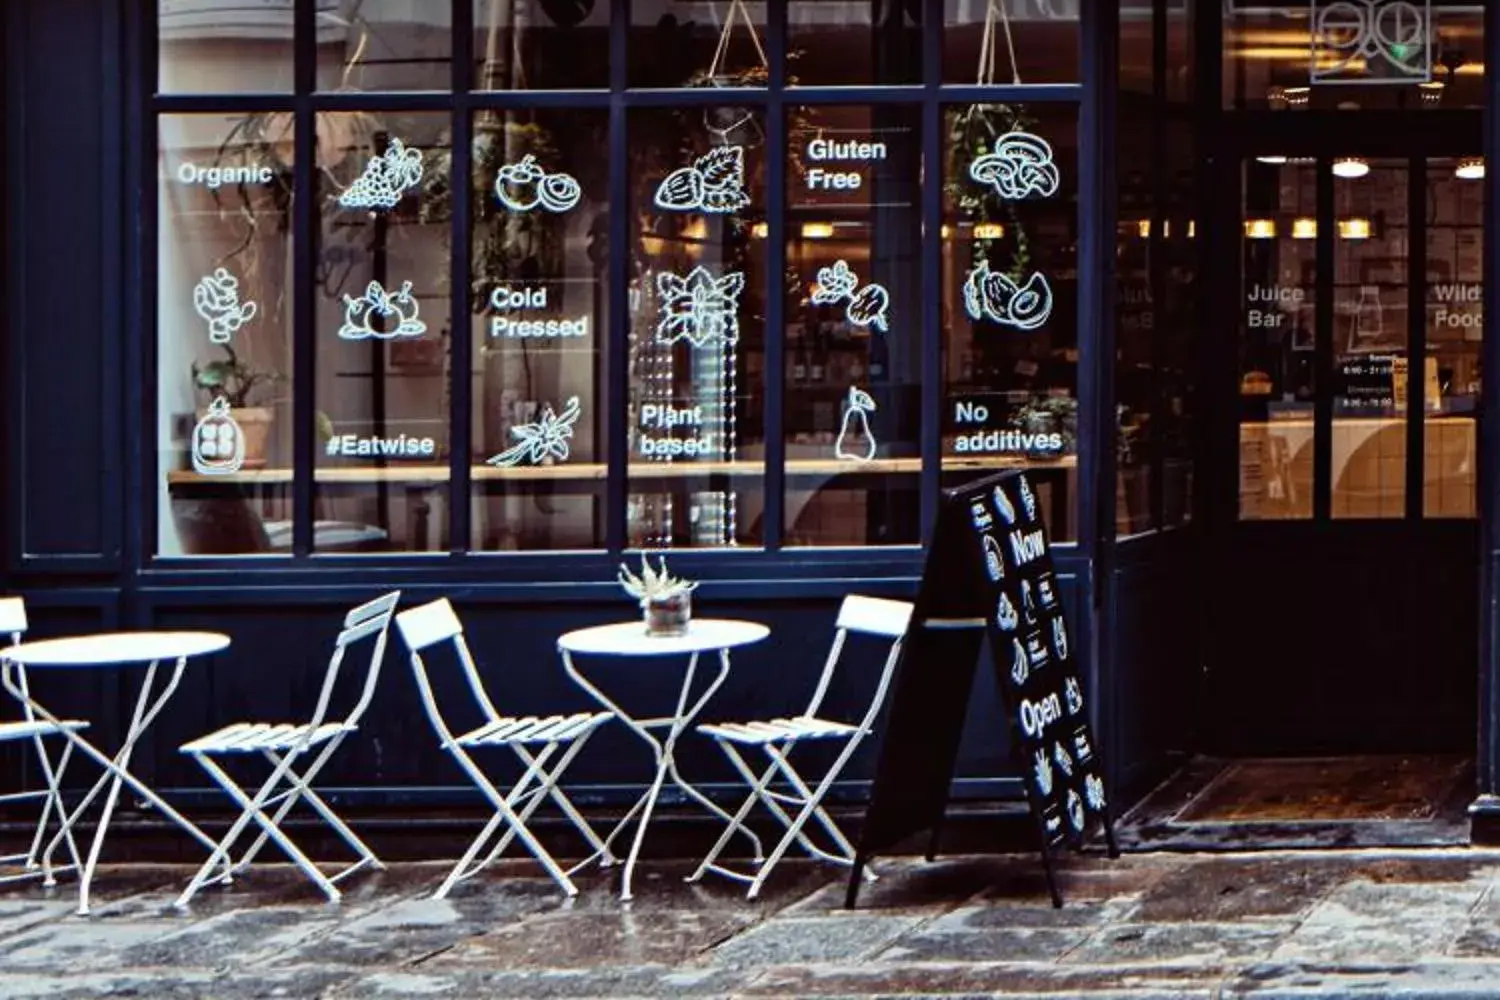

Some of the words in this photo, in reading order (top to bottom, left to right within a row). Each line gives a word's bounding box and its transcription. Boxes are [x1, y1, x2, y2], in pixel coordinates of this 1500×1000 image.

[807, 138, 886, 160] Gluten
[177, 162, 273, 188] Organic
[807, 168, 862, 189] Free
[491, 287, 547, 309] Cold
[1248, 284, 1304, 302] Juice
[1435, 284, 1481, 301] Wild
[491, 315, 588, 338] Pressed
[1248, 309, 1284, 327] Bar
[641, 405, 702, 426] Plant
[955, 402, 988, 423] No
[326, 433, 435, 456] #Eatwise
[640, 433, 712, 455] based
[954, 427, 1063, 452] additives
[1009, 528, 1045, 567] Now
[1020, 692, 1062, 739] Open
